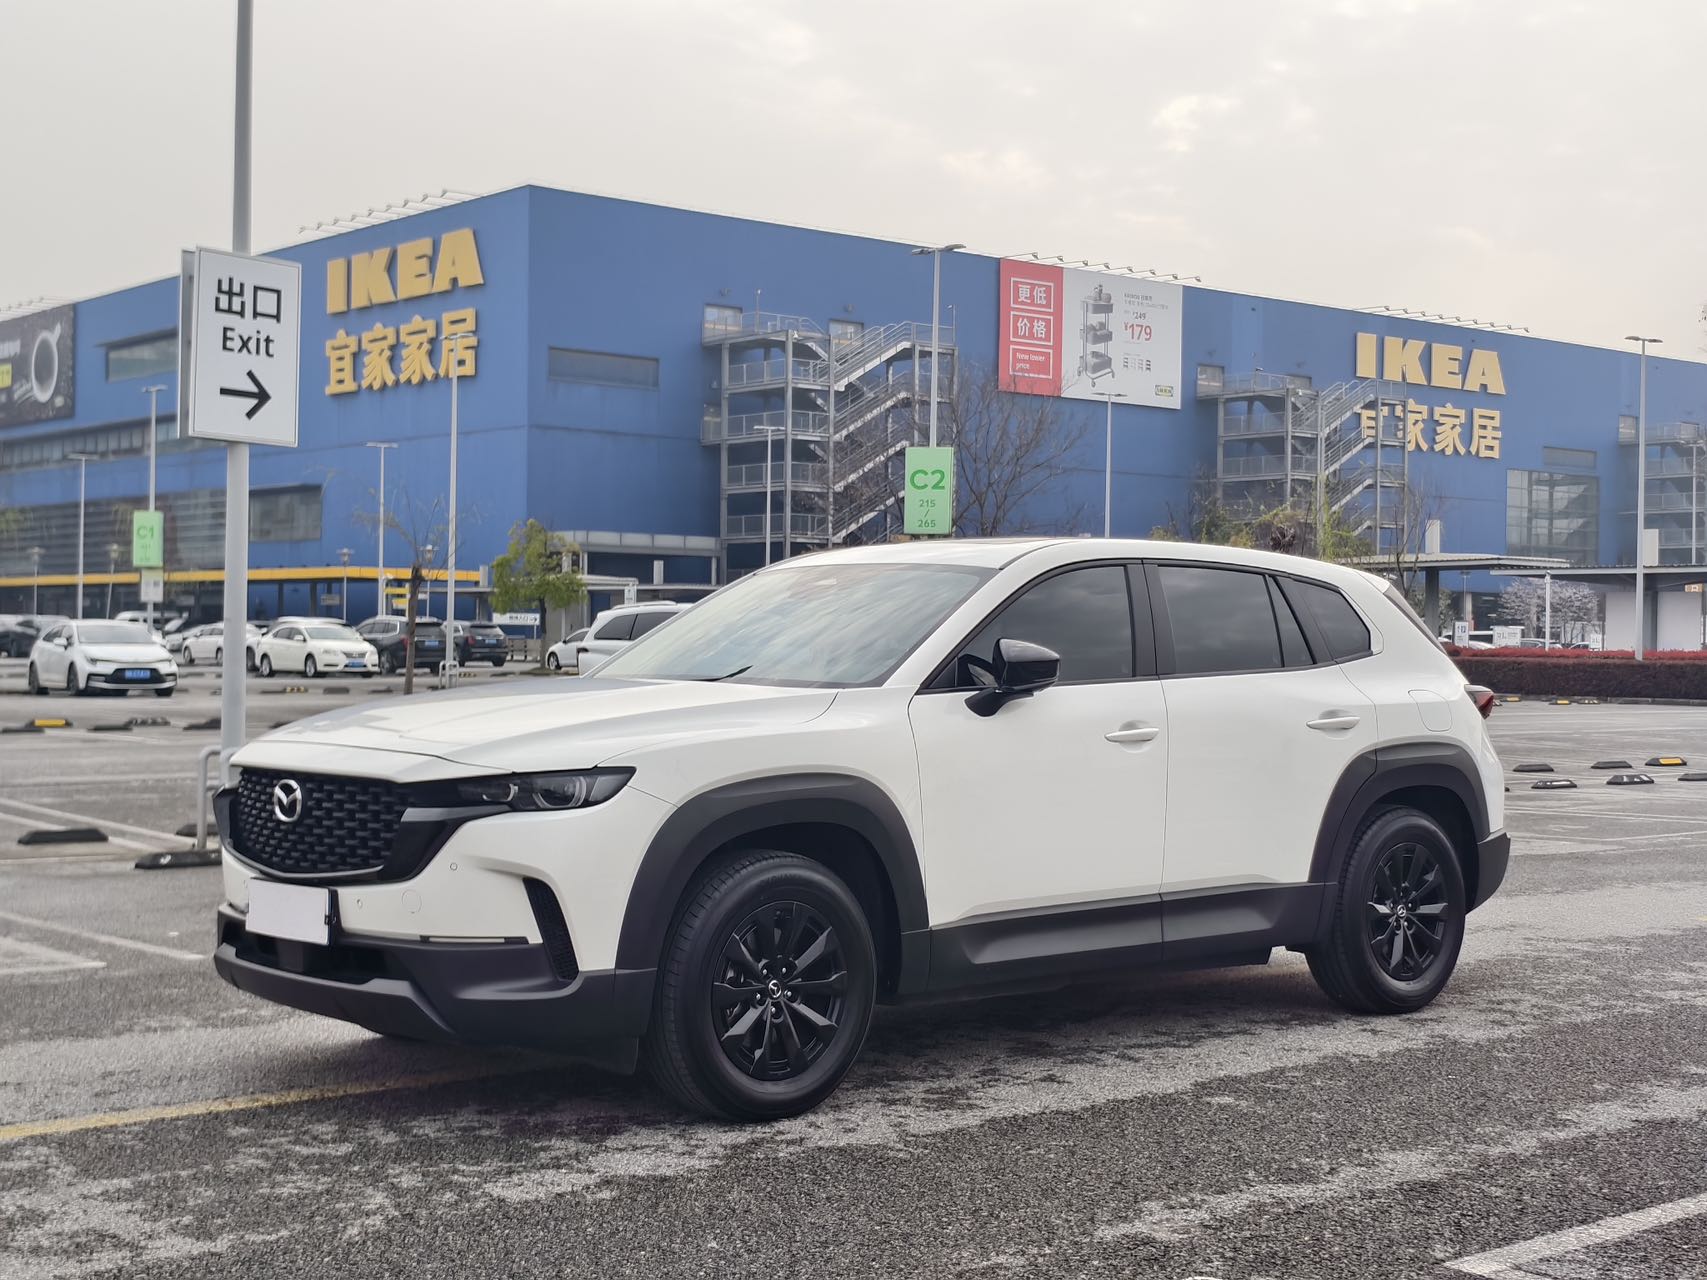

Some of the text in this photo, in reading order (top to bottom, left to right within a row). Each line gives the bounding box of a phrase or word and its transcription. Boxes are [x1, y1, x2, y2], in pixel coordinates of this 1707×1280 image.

[327, 227, 485, 315] IKEA
[215, 277, 282, 324] 出口
[1017, 284, 1047, 305] 更低
[1017, 318, 1046, 338] 价格
[1124, 322, 1152, 341] ¥179
[222, 326, 275, 358] Exit
[325, 307, 479, 396] 宜家家居
[1015, 362, 1030, 370] price
[1016, 352, 1045, 361] New lower
[1356, 332, 1507, 395] IKEA
[909, 469, 945, 490] C2
[919, 499, 936, 508] 215
[137, 525, 154, 539] C1
[918, 519, 936, 528] 265
